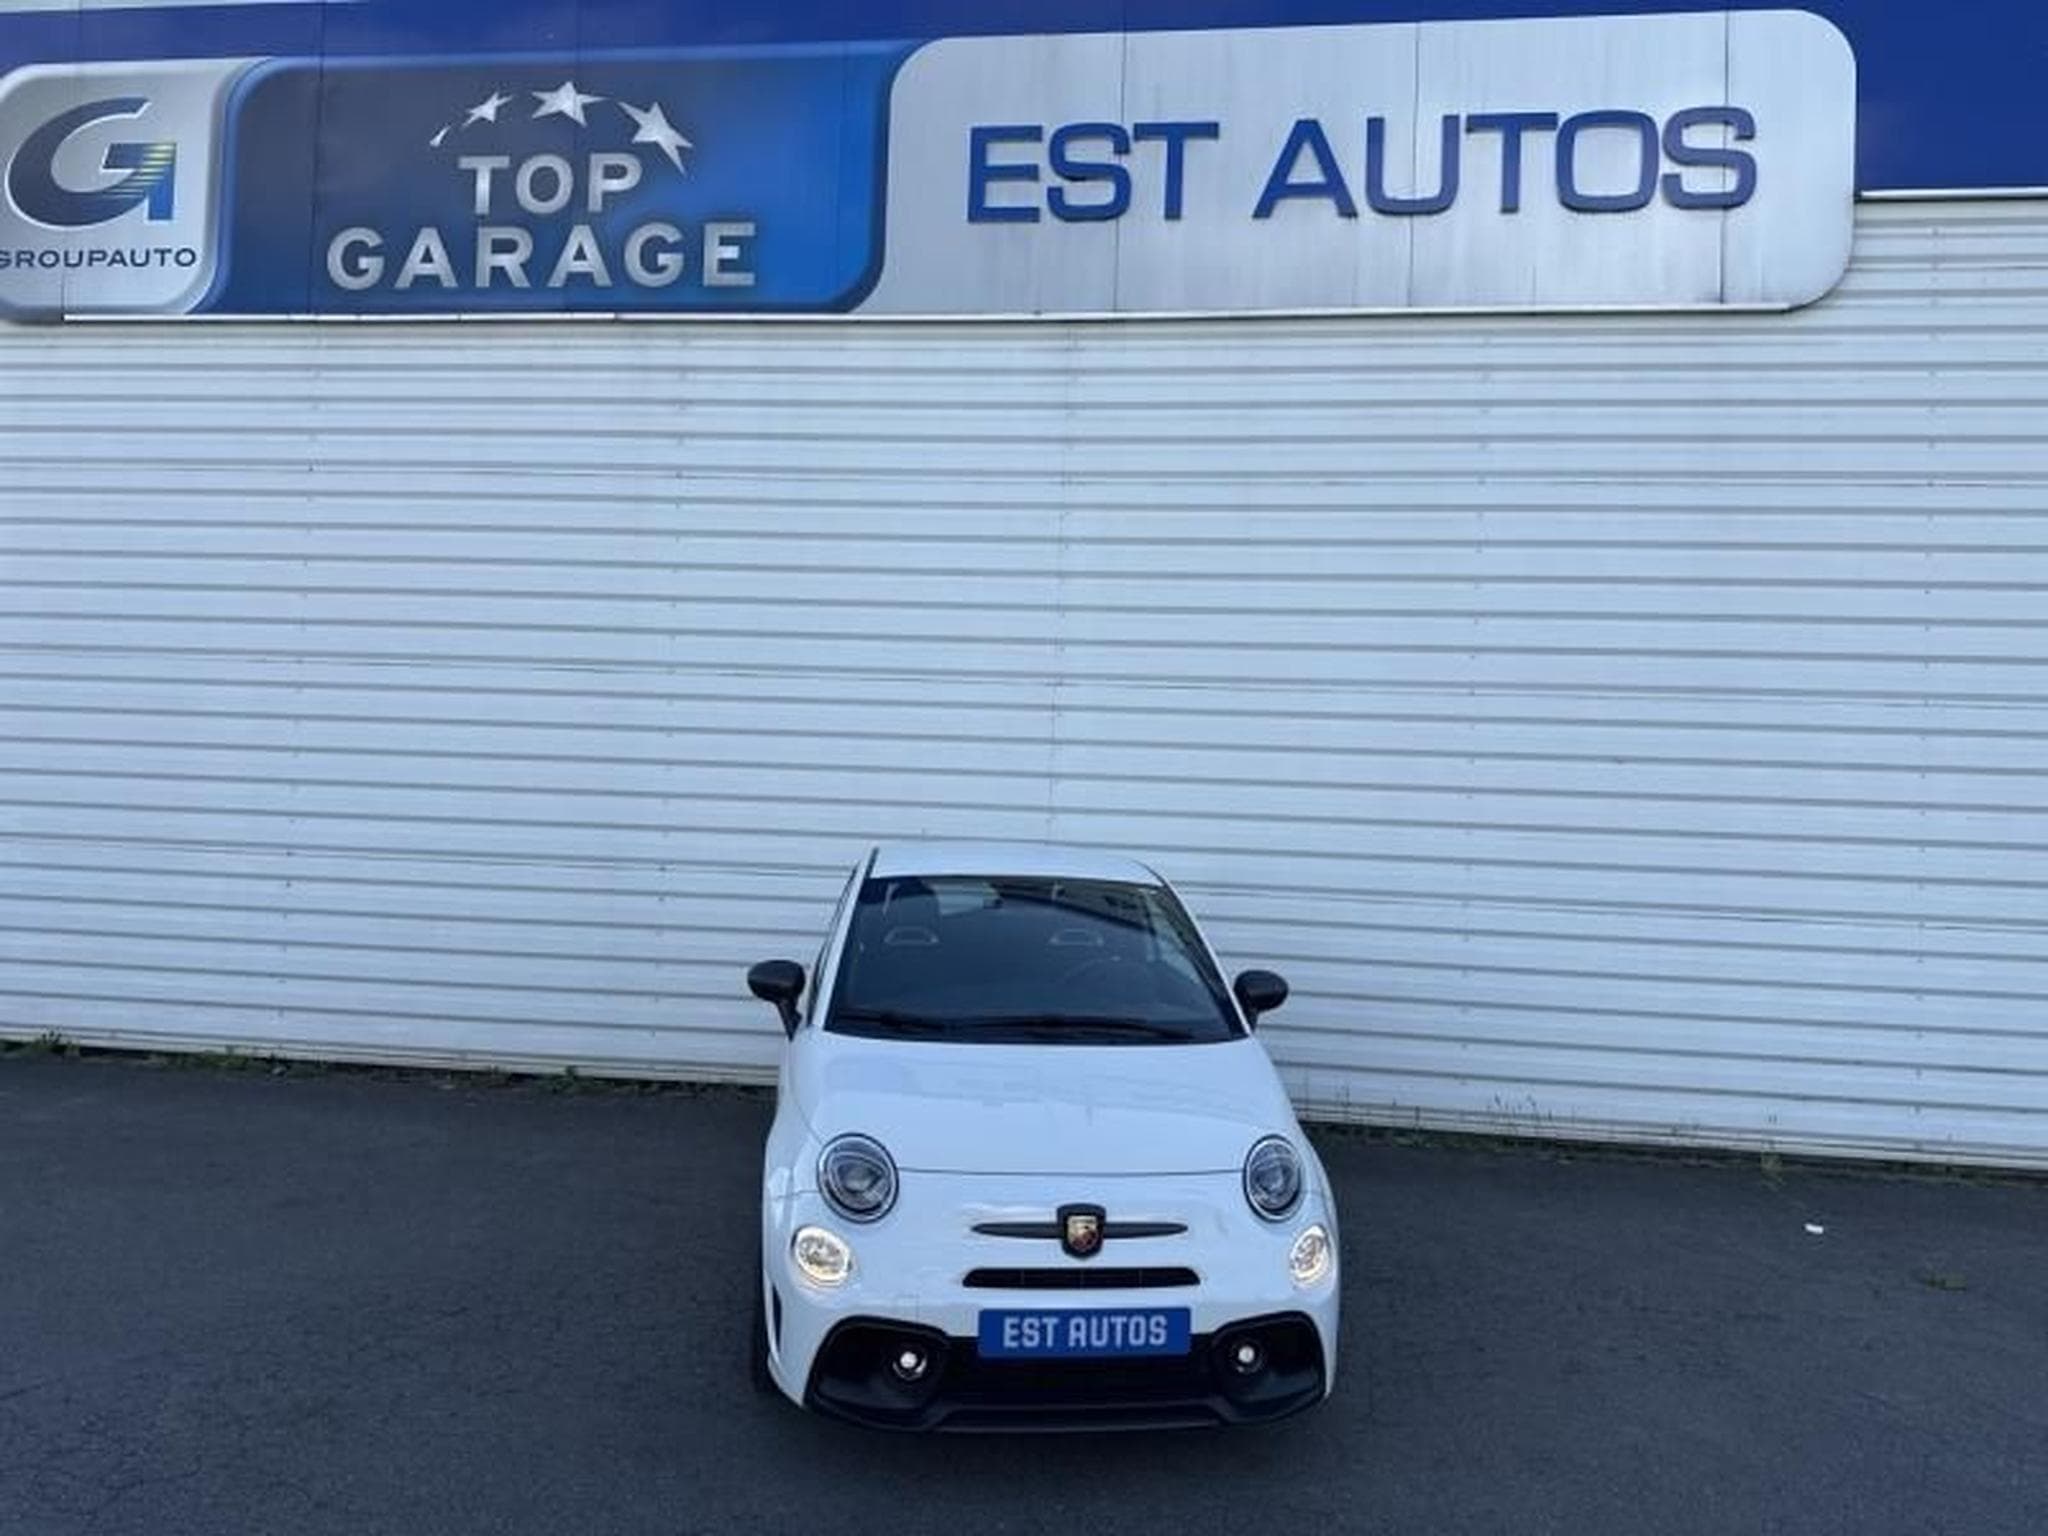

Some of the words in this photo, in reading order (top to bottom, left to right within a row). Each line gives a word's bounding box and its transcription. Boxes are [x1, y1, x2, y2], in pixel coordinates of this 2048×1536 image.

[458, 153, 644, 215] TOP
[967, 121, 1219, 223] EST
[1253, 106, 1757, 219] AUTOS
[326, 222, 757, 290] GARAGE
[1003, 1317, 1058, 1348] EST
[1069, 1315, 1168, 1346] AUTOS
